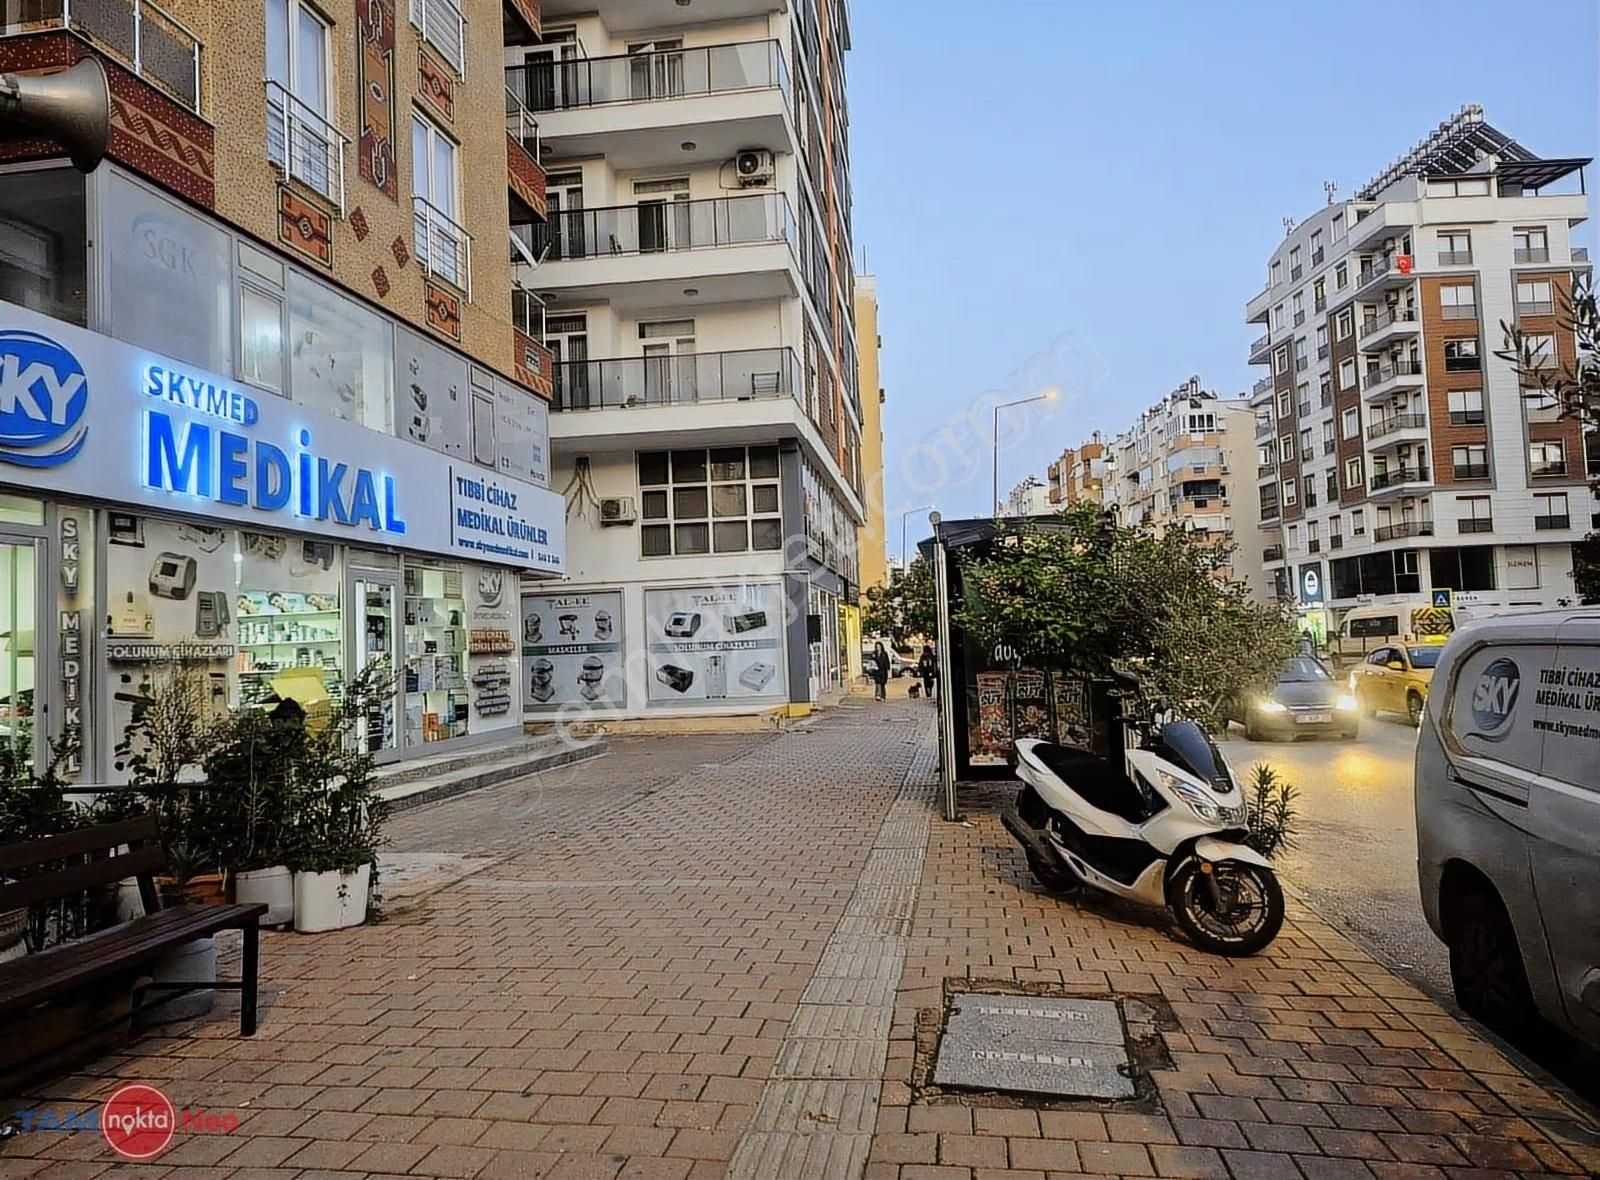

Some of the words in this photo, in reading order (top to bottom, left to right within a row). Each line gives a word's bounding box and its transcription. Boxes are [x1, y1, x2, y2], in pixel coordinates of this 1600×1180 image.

[0, 353, 86, 426] KY
[146, 365, 259, 426] SKYMED
[144, 409, 407, 534] MEDİKAL
[456, 477, 485, 502] TIBBİ
[486, 481, 518, 511] CİHAZ
[457, 507, 506, 537] MEDİKAL
[60, 517, 79, 589] SKY
[1474, 674, 1520, 715] SKY
[1540, 666, 1566, 686] TIBBİ
[1535, 688, 1581, 710] MEDİKAL
